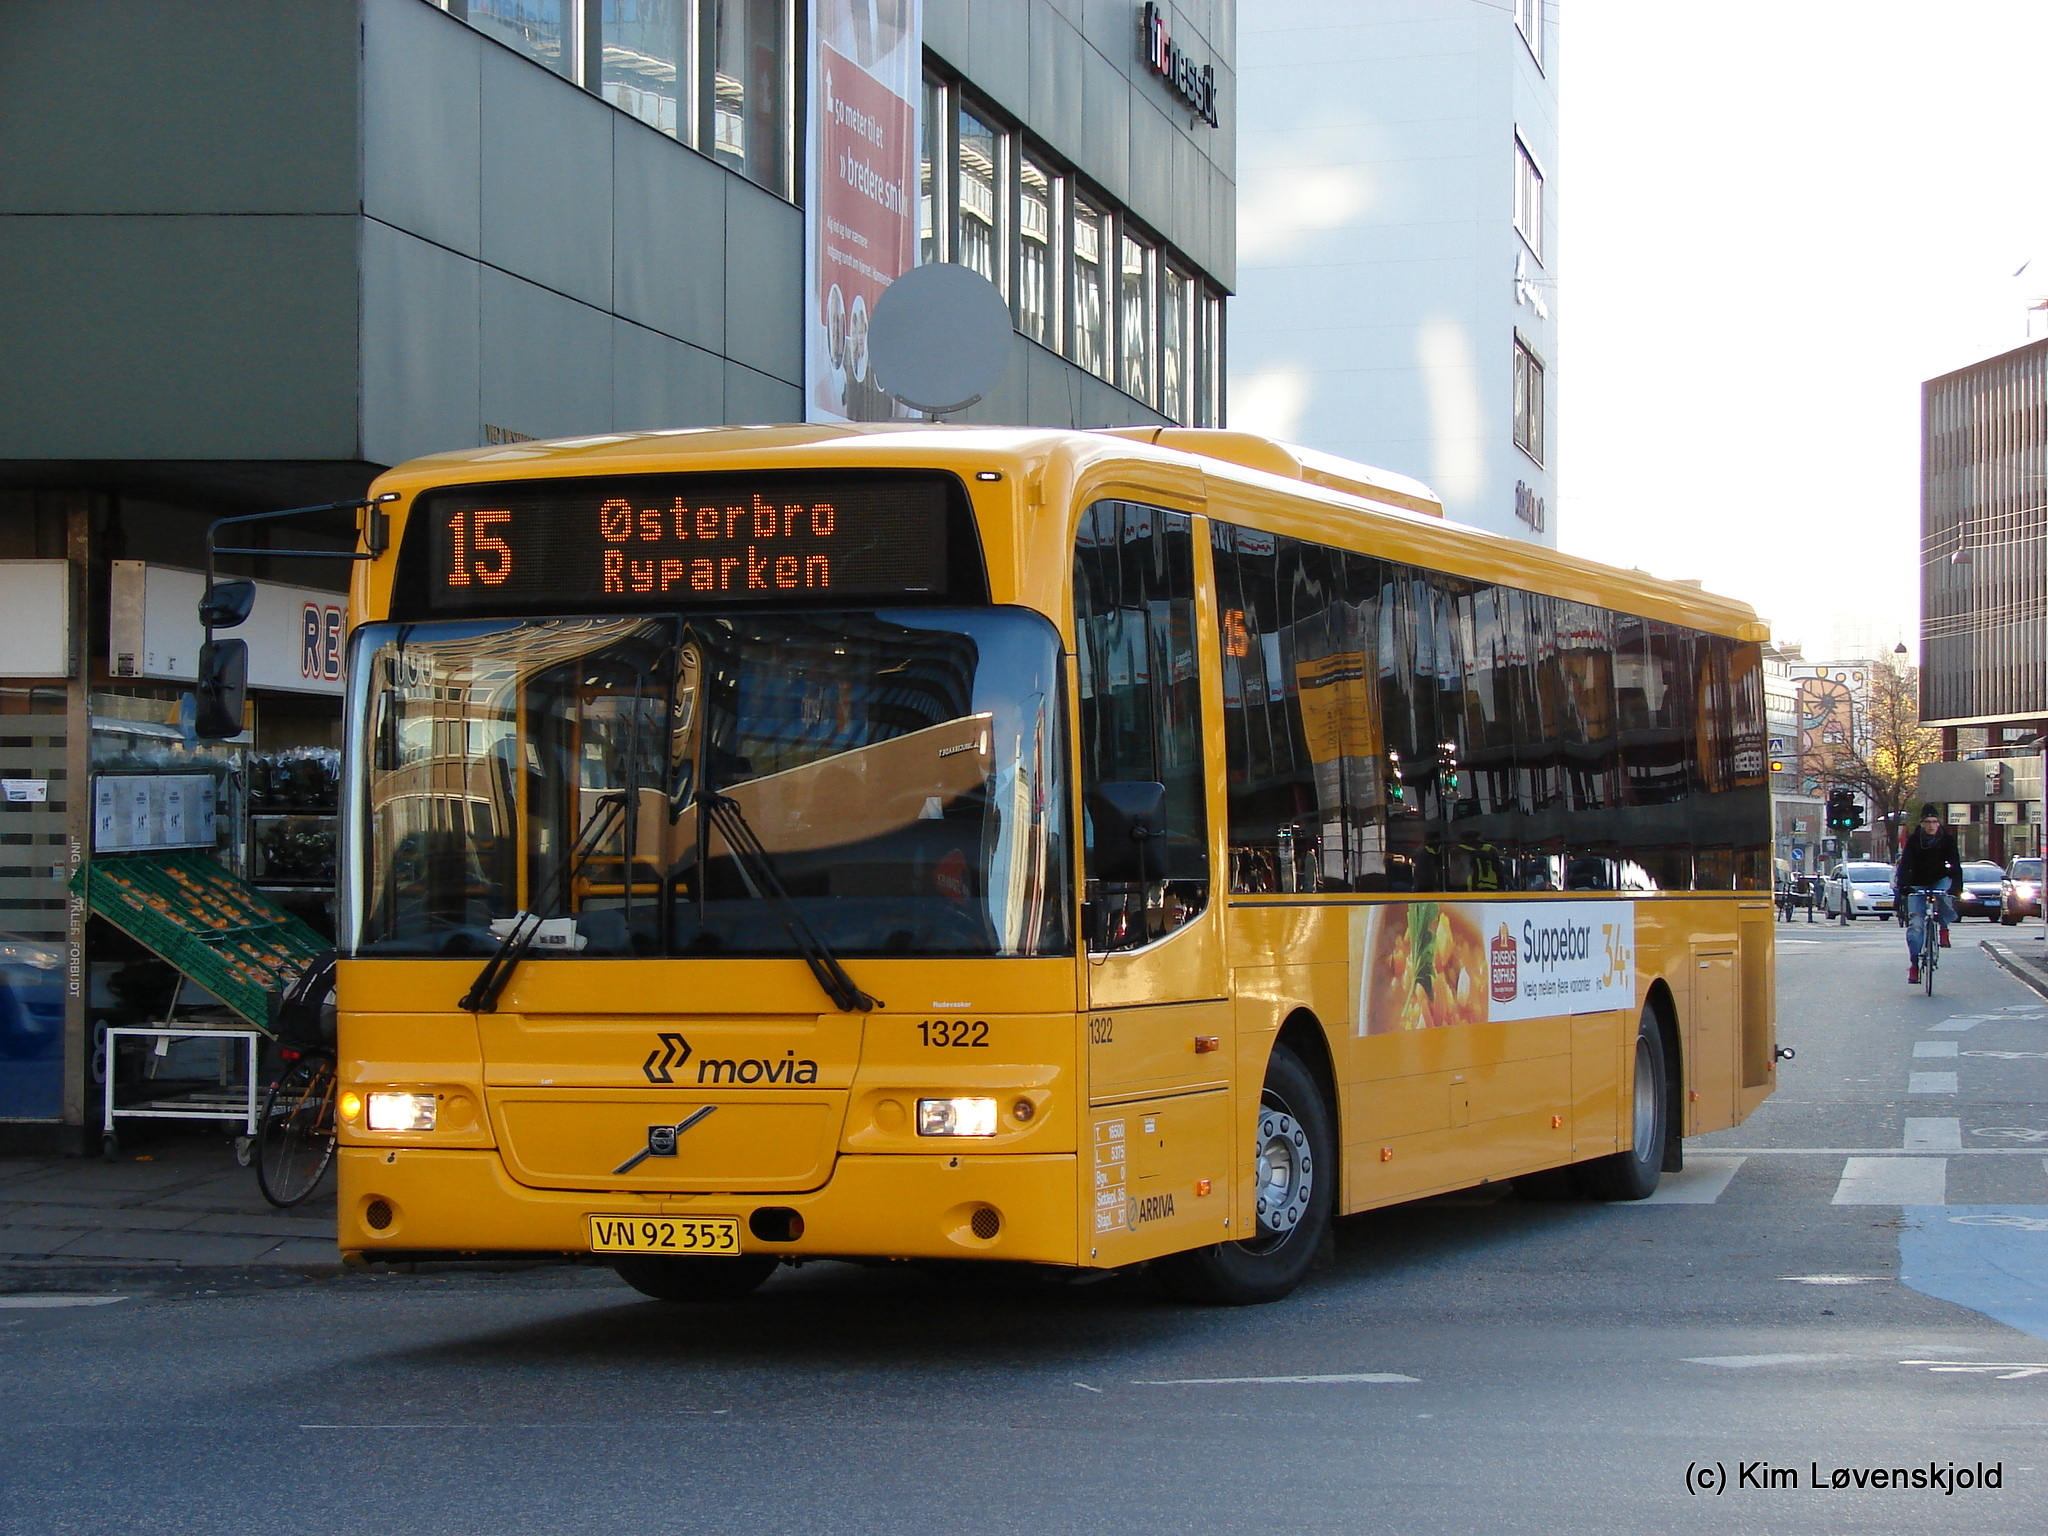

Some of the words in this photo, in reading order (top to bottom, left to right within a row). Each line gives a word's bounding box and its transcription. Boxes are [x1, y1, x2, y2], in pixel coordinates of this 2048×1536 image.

[835, 98, 844, 125] 50
[845, 105, 867, 138] meter
[867, 115, 875, 144] til
[876, 125, 883, 149] et
[848, 146, 883, 205] bredere
[448, 510, 512, 587] 15
[600, 494, 835, 543] Østerbro
[603, 545, 830, 594] Ryparken
[301, 602, 349, 682] RE
[1224, 609, 1247, 657] 15
[70, 941, 80, 997] FORBUDT
[1523, 918, 1590, 973] Suppebar
[917, 1020, 989, 1047] 1322
[1089, 1017, 1113, 1044] 1322
[697, 1050, 818, 1084] movia
[1139, 1193, 1175, 1223] ARRIVA
[596, 1221, 635, 1246] VN
[641, 1223, 675, 1248] 92
[684, 1224, 734, 1250] 353
